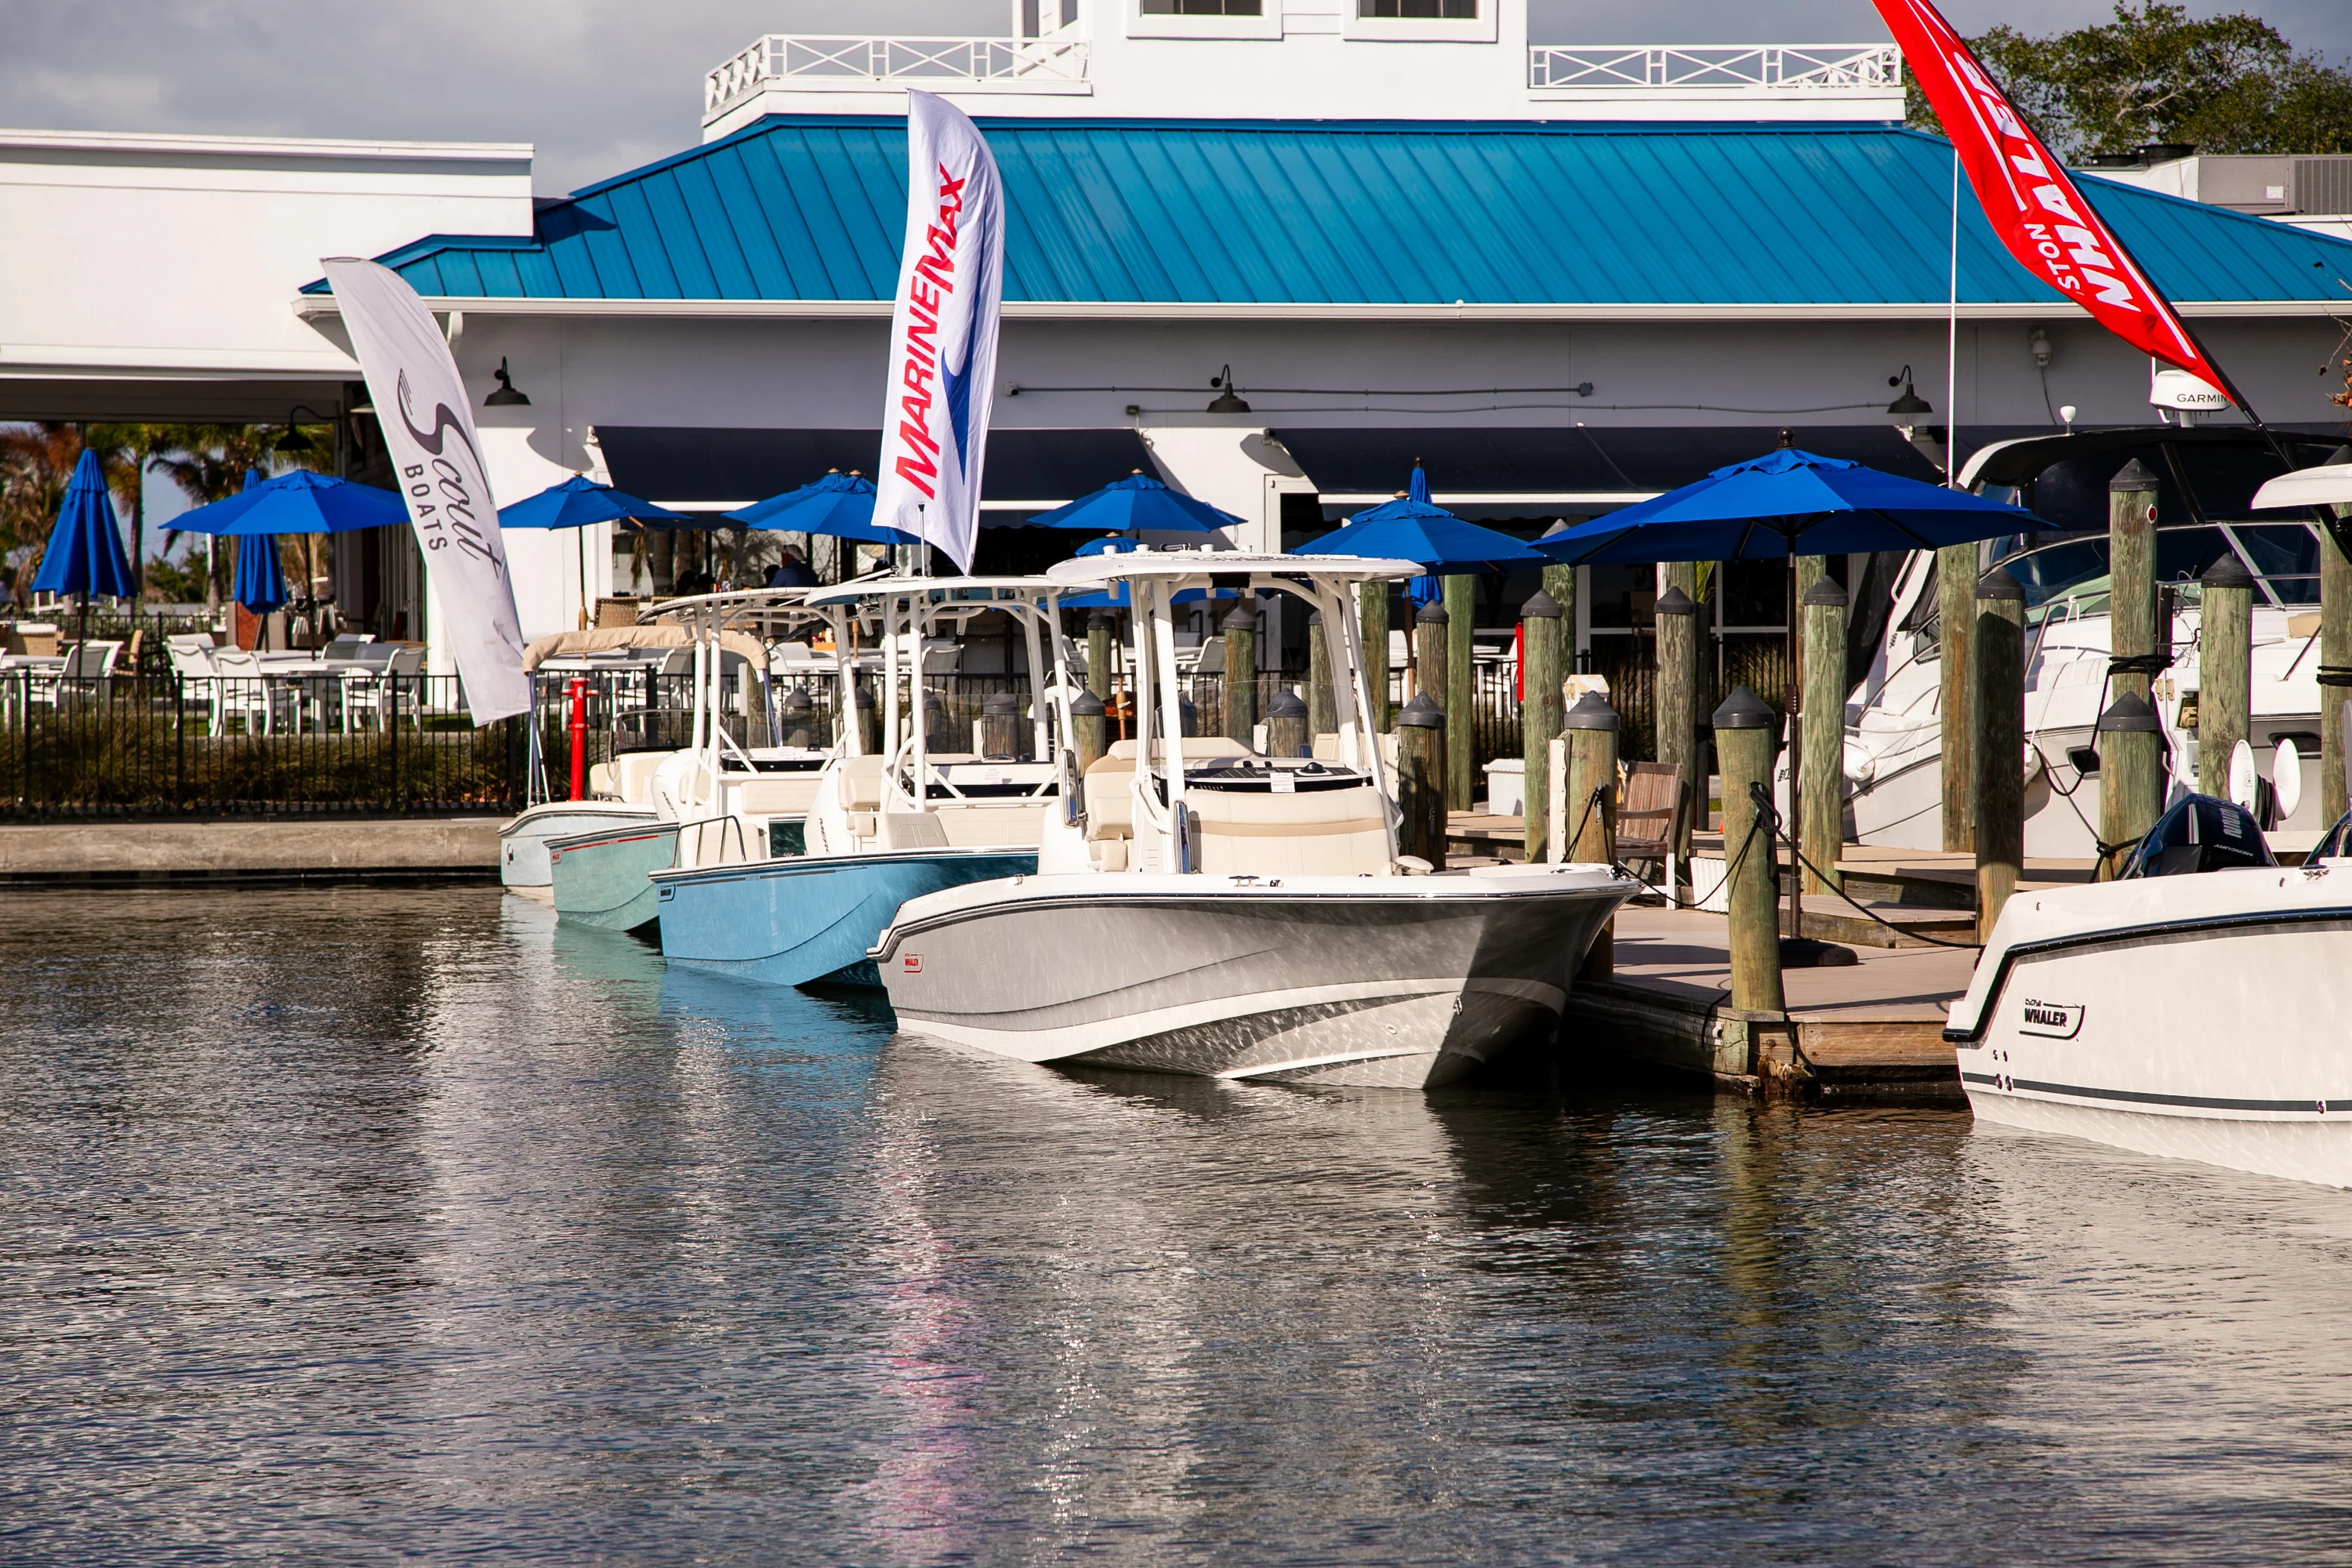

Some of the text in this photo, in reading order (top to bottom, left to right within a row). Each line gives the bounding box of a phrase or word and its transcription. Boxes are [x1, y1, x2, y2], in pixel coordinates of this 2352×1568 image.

[2024, 223, 2085, 296] STON
[895, 160, 966, 500] MARINEMAX
[2176, 394, 2227, 403] GARMIN
[397, 368, 502, 579] Scout
[405, 463, 448, 550] BOATS
[2214, 844, 2254, 857] MERCURY
[2024, 1007, 2067, 1028] WHALER
